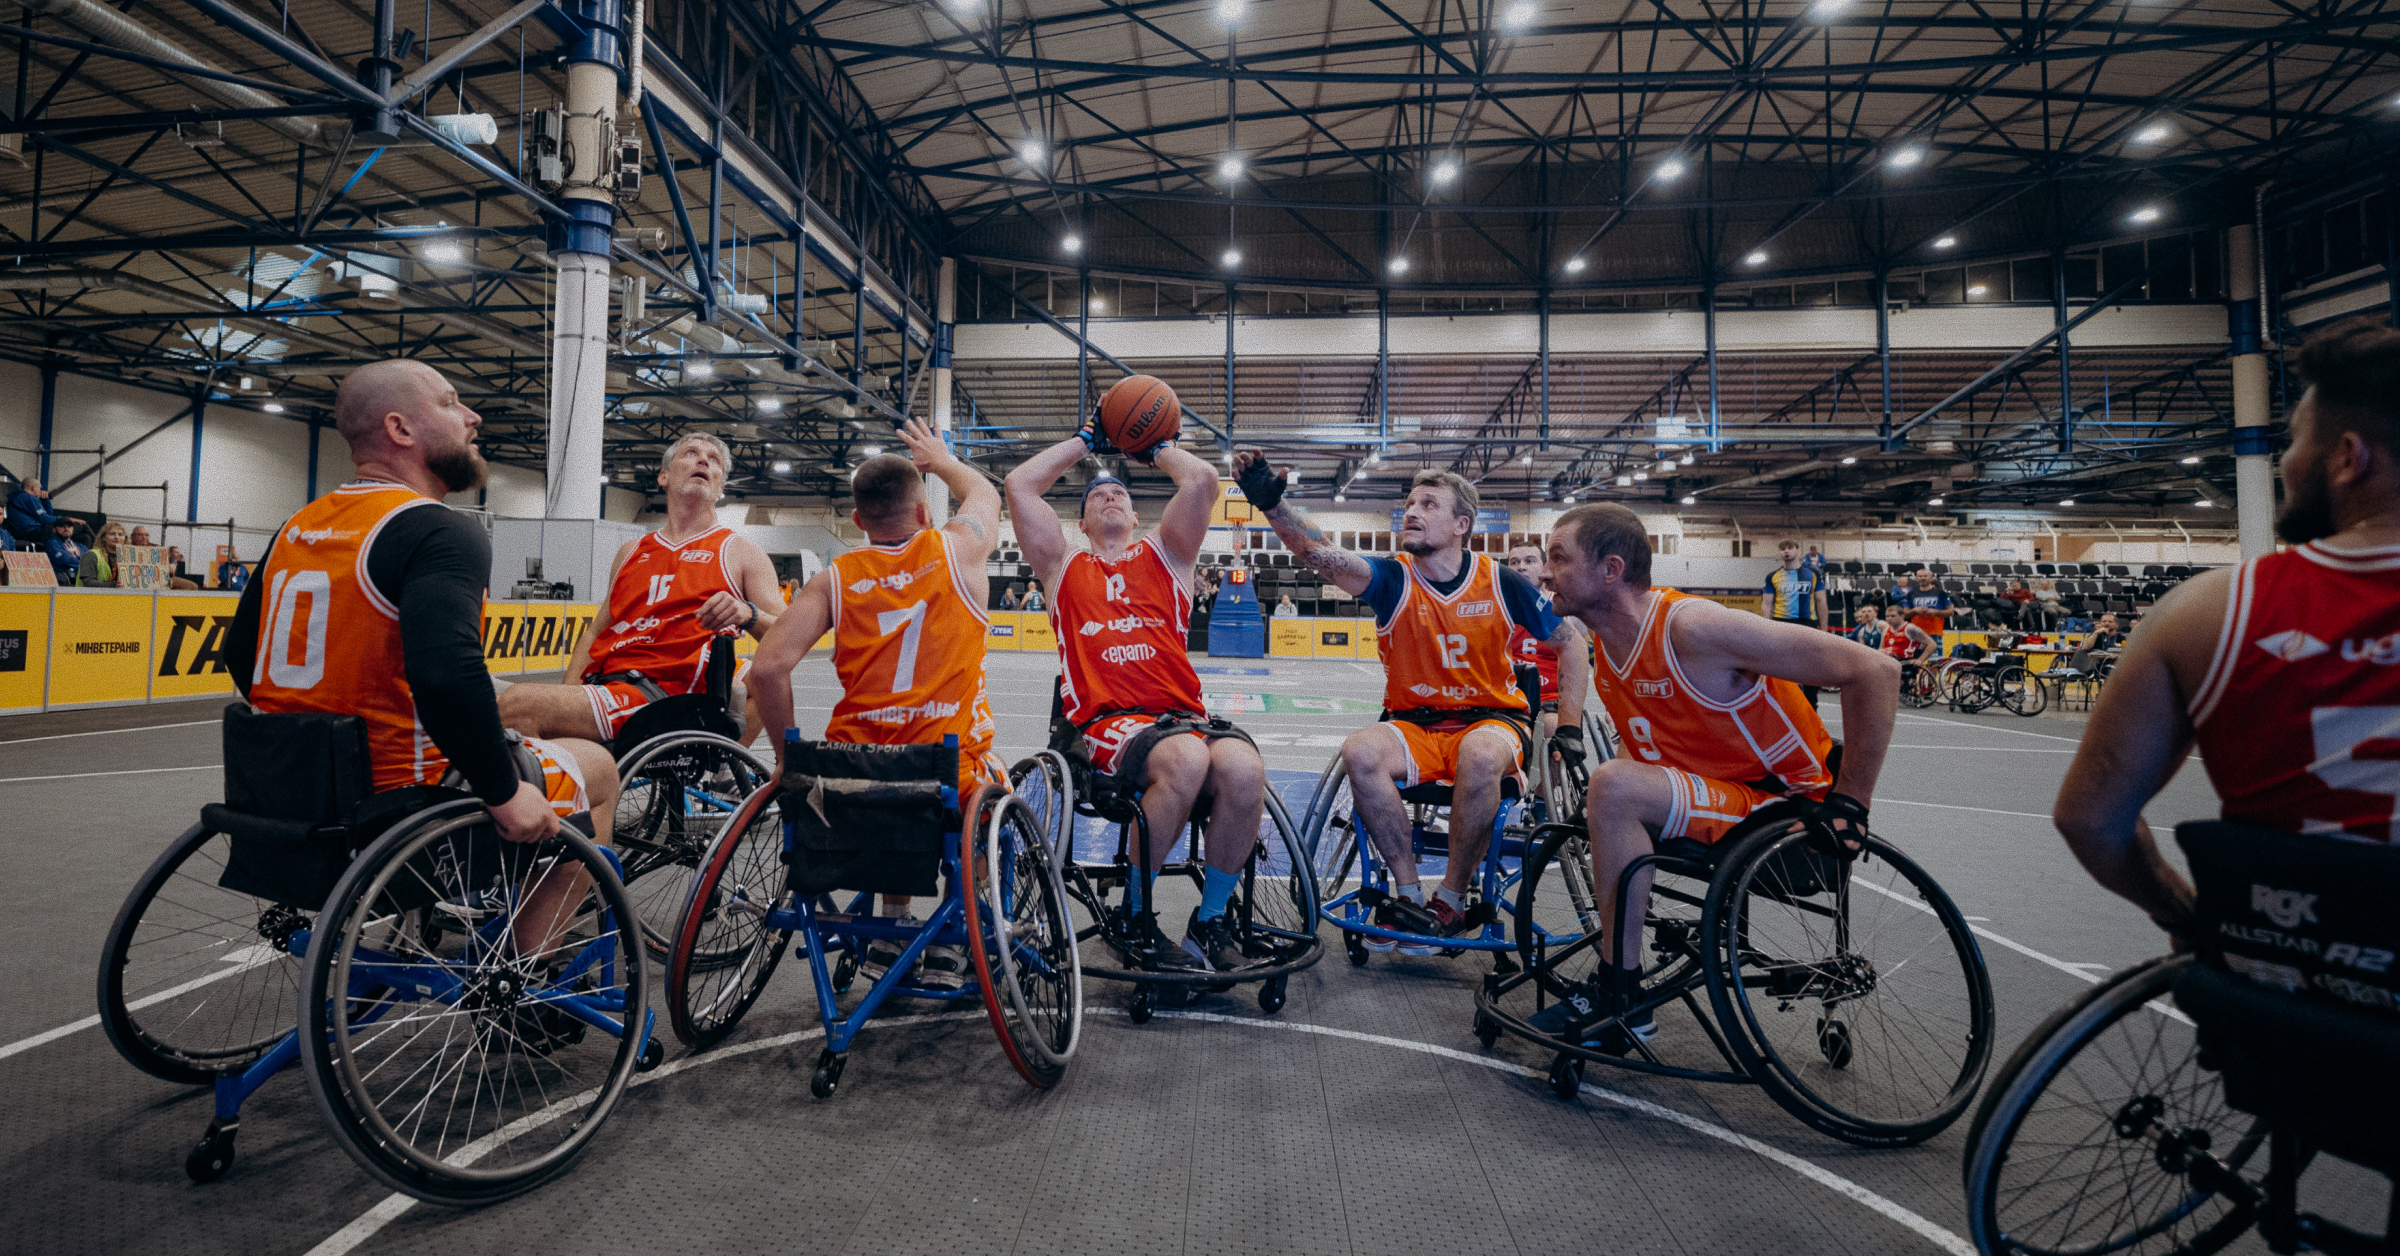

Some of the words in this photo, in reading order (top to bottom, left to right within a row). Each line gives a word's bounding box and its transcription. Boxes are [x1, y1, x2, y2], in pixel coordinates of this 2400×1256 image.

[1126, 394, 1166, 440] Wilson
[879, 569, 914, 590] ugb
[1232, 570, 1246, 583] 13
[1460, 602, 1491, 615] ГАРТ
[253, 569, 331, 690] 10
[1108, 613, 1143, 633] ugb
[76, 641, 140, 655] МІНВЕТЕРАНІВ
[877, 599, 928, 694] 7
[1436, 633, 1470, 669] 12
[2341, 632, 2400, 667] ug
[1441, 684, 1478, 700] ugb
[1636, 681, 1668, 695] ГАРТ
[1628, 716, 1662, 760] 9
[676, 756, 693, 766] A2
[2323, 941, 2396, 973] A2
